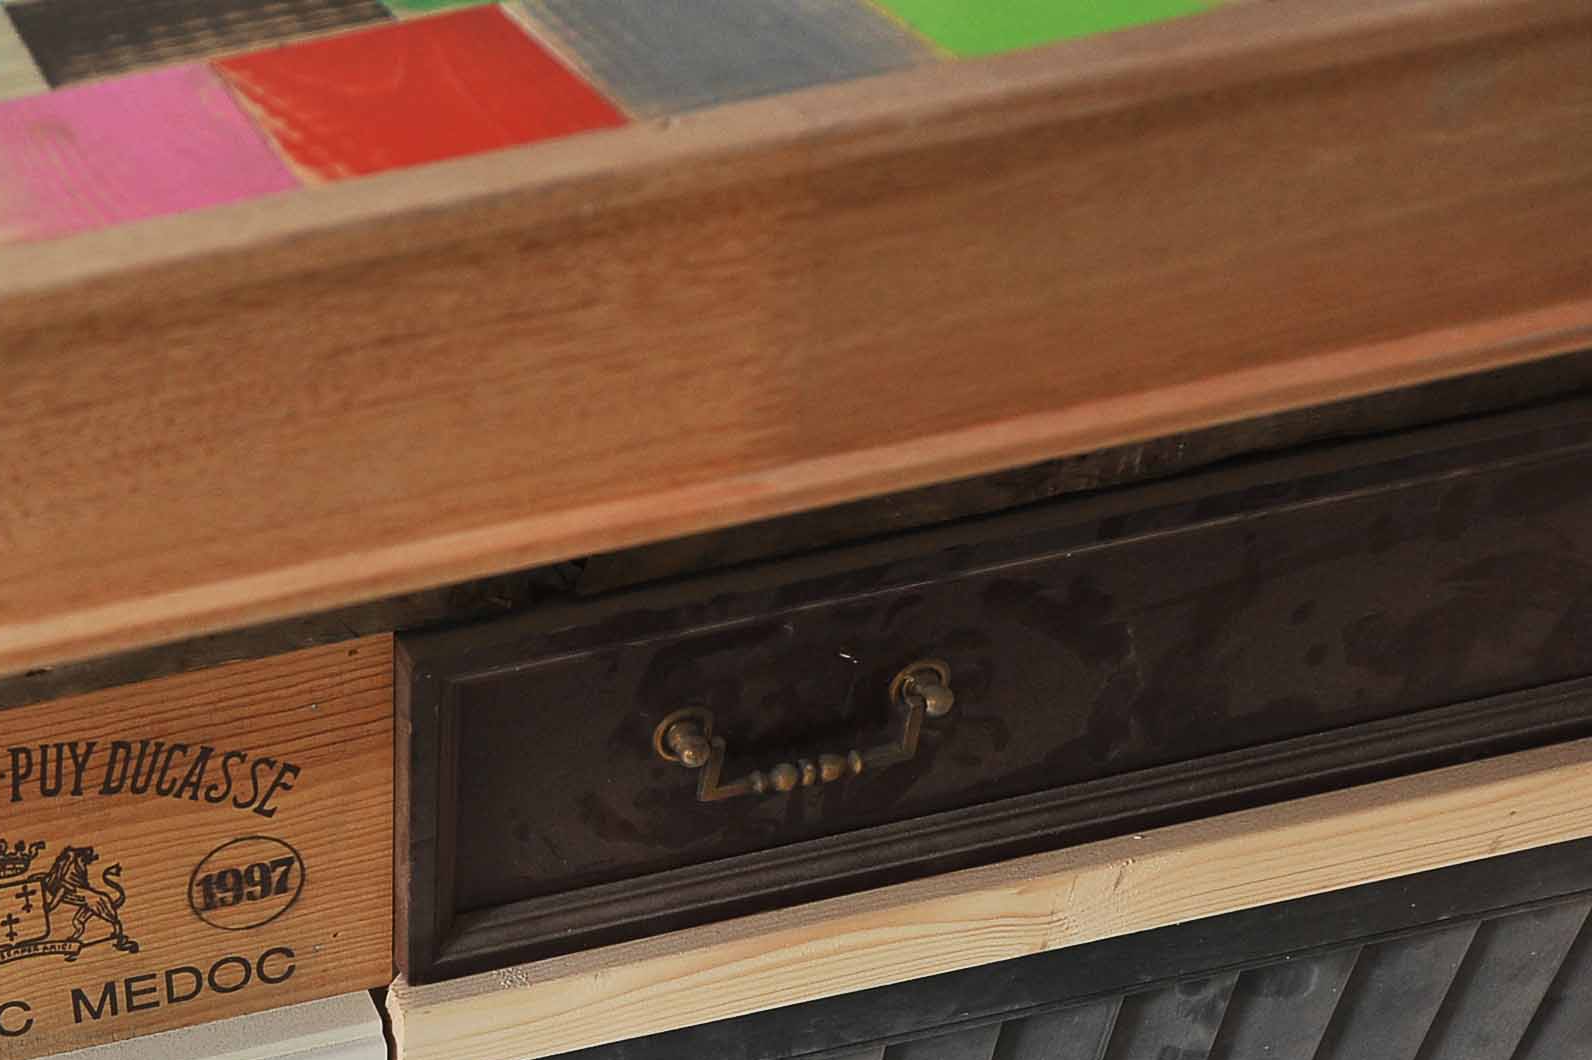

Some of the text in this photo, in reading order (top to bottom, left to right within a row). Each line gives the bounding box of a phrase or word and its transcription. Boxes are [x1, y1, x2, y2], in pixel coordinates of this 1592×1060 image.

[102, 740, 301, 818] DUCASSE
[195, 857, 296, 912] 1997
[72, 947, 297, 1024] MEDOC
